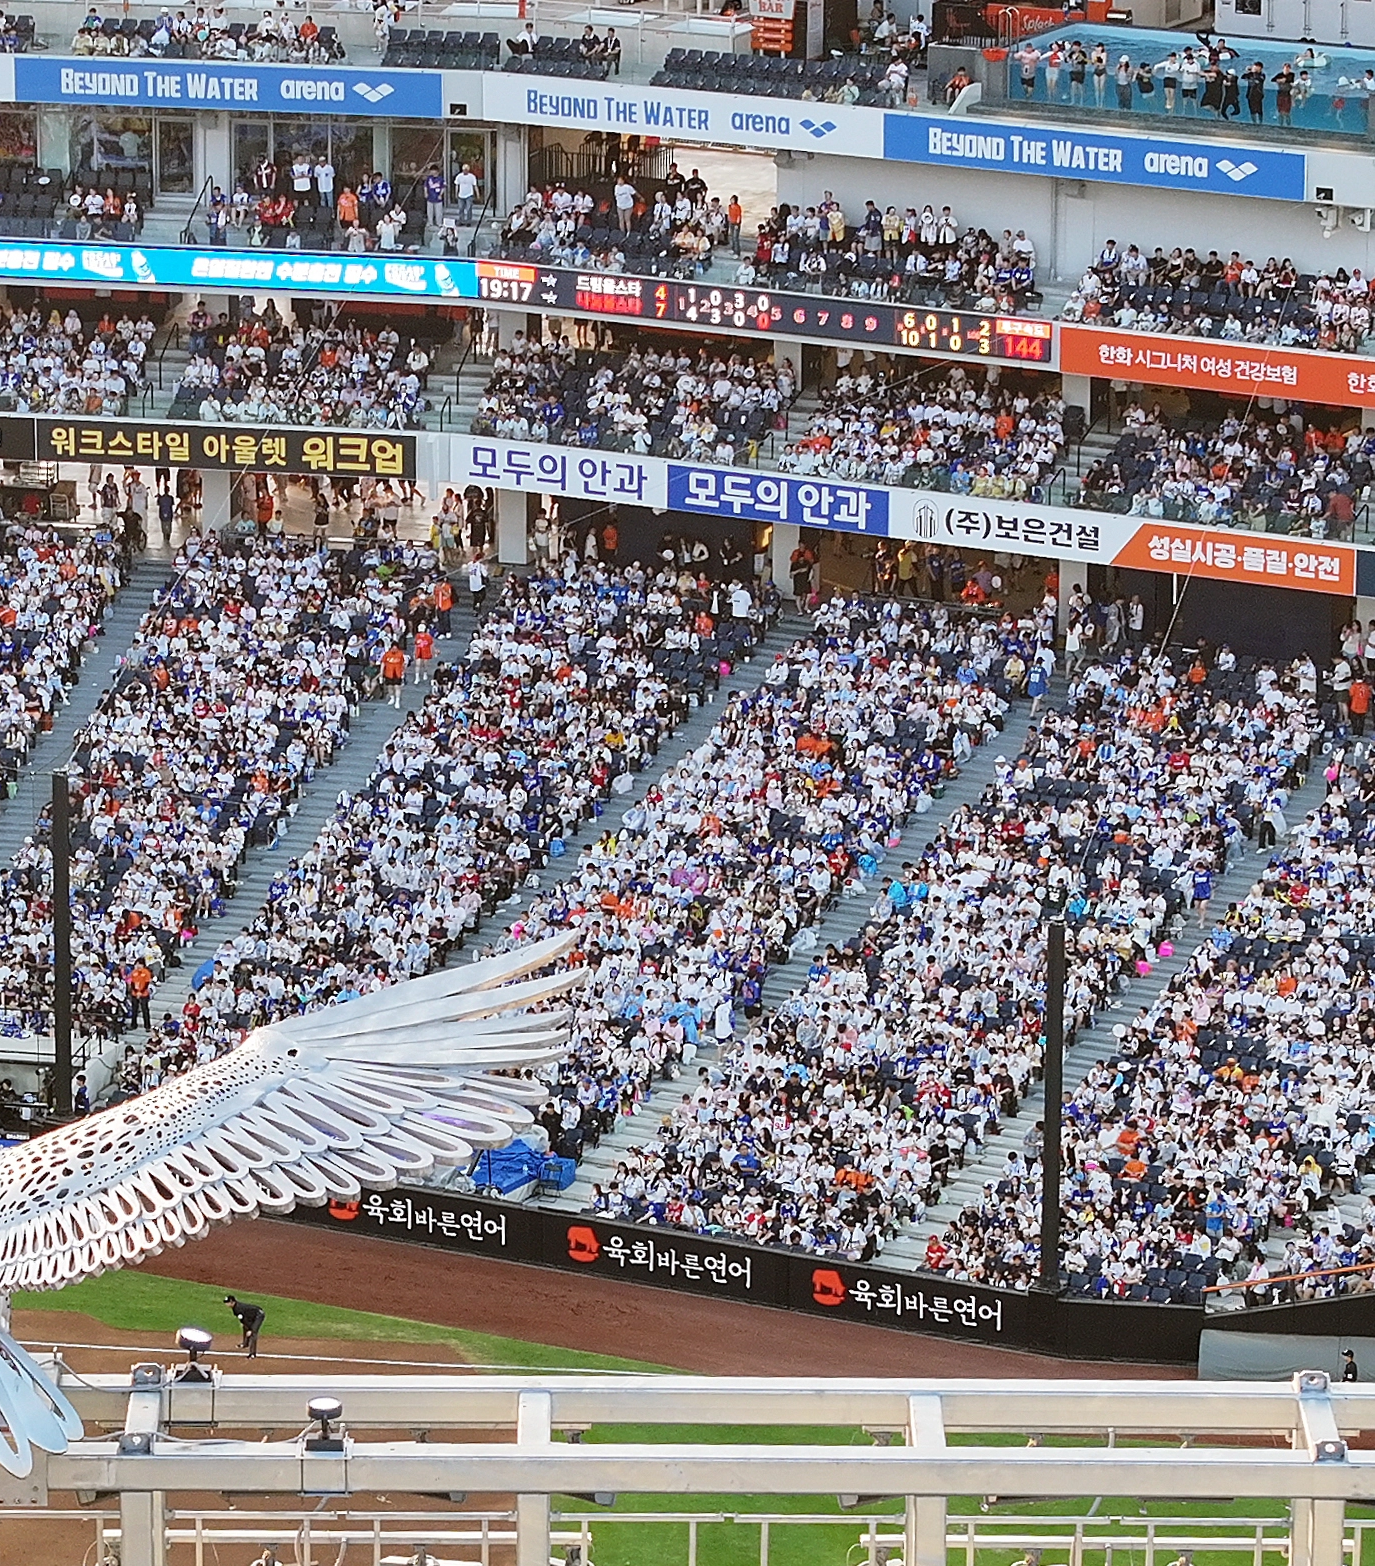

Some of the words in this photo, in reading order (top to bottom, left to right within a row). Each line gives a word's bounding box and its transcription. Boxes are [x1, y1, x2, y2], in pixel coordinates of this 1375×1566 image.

[281, 78, 345, 102] arena
[731, 112, 790, 135] arena
[1144, 151, 1208, 178] arena
[493, 266, 520, 278] TIME
[480, 278, 532, 302] 19:17
[576, 275, 642, 296] 드림올스타
[655, 284, 667, 300] 4
[688, 288, 696, 303] 1
[710, 290, 721, 306] 0
[734, 292, 745, 309] 3
[758, 295, 769, 312] 0
[656, 302, 667, 318] 7
[686, 305, 698, 321] 4
[710, 308, 721, 324] 3
[734, 310, 745, 327] 0
[771, 306, 782, 321] 5
[793, 308, 806, 324] 6
[817, 311, 829, 326] 7
[757, 313, 770, 330] 0
[841, 313, 853, 329] 8
[865, 316, 878, 331] 9
[903, 312, 915, 328] 6
[925, 314, 937, 331] 0
[951, 317, 959, 332] 1
[979, 320, 990, 336] 2
[901, 329, 919, 346] 10
[929, 332, 937, 348] 1
[950, 335, 962, 351] 0
[979, 338, 989, 354] 3
[1004, 336, 1042, 360] 144
[1099, 343, 1132, 366] 한화
[1136, 350, 1196, 374] 시그니처
[1200, 358, 1231, 377] 여성
[1234, 360, 1297, 385] 건강보험
[50, 427, 190, 462] 워크스타일
[203, 434, 287, 467] 아울렛
[301, 437, 403, 475] 워크업
[469, 446, 567, 491] 모두의
[578, 458, 648, 501] 안과
[684, 472, 788, 518] 모두의
[799, 484, 872, 530] 안과
[362, 1197, 508, 1245] 육회바른연어
[603, 1235, 751, 1289] 육회바른연어
[848, 1278, 1003, 1331] 육회바른연어
